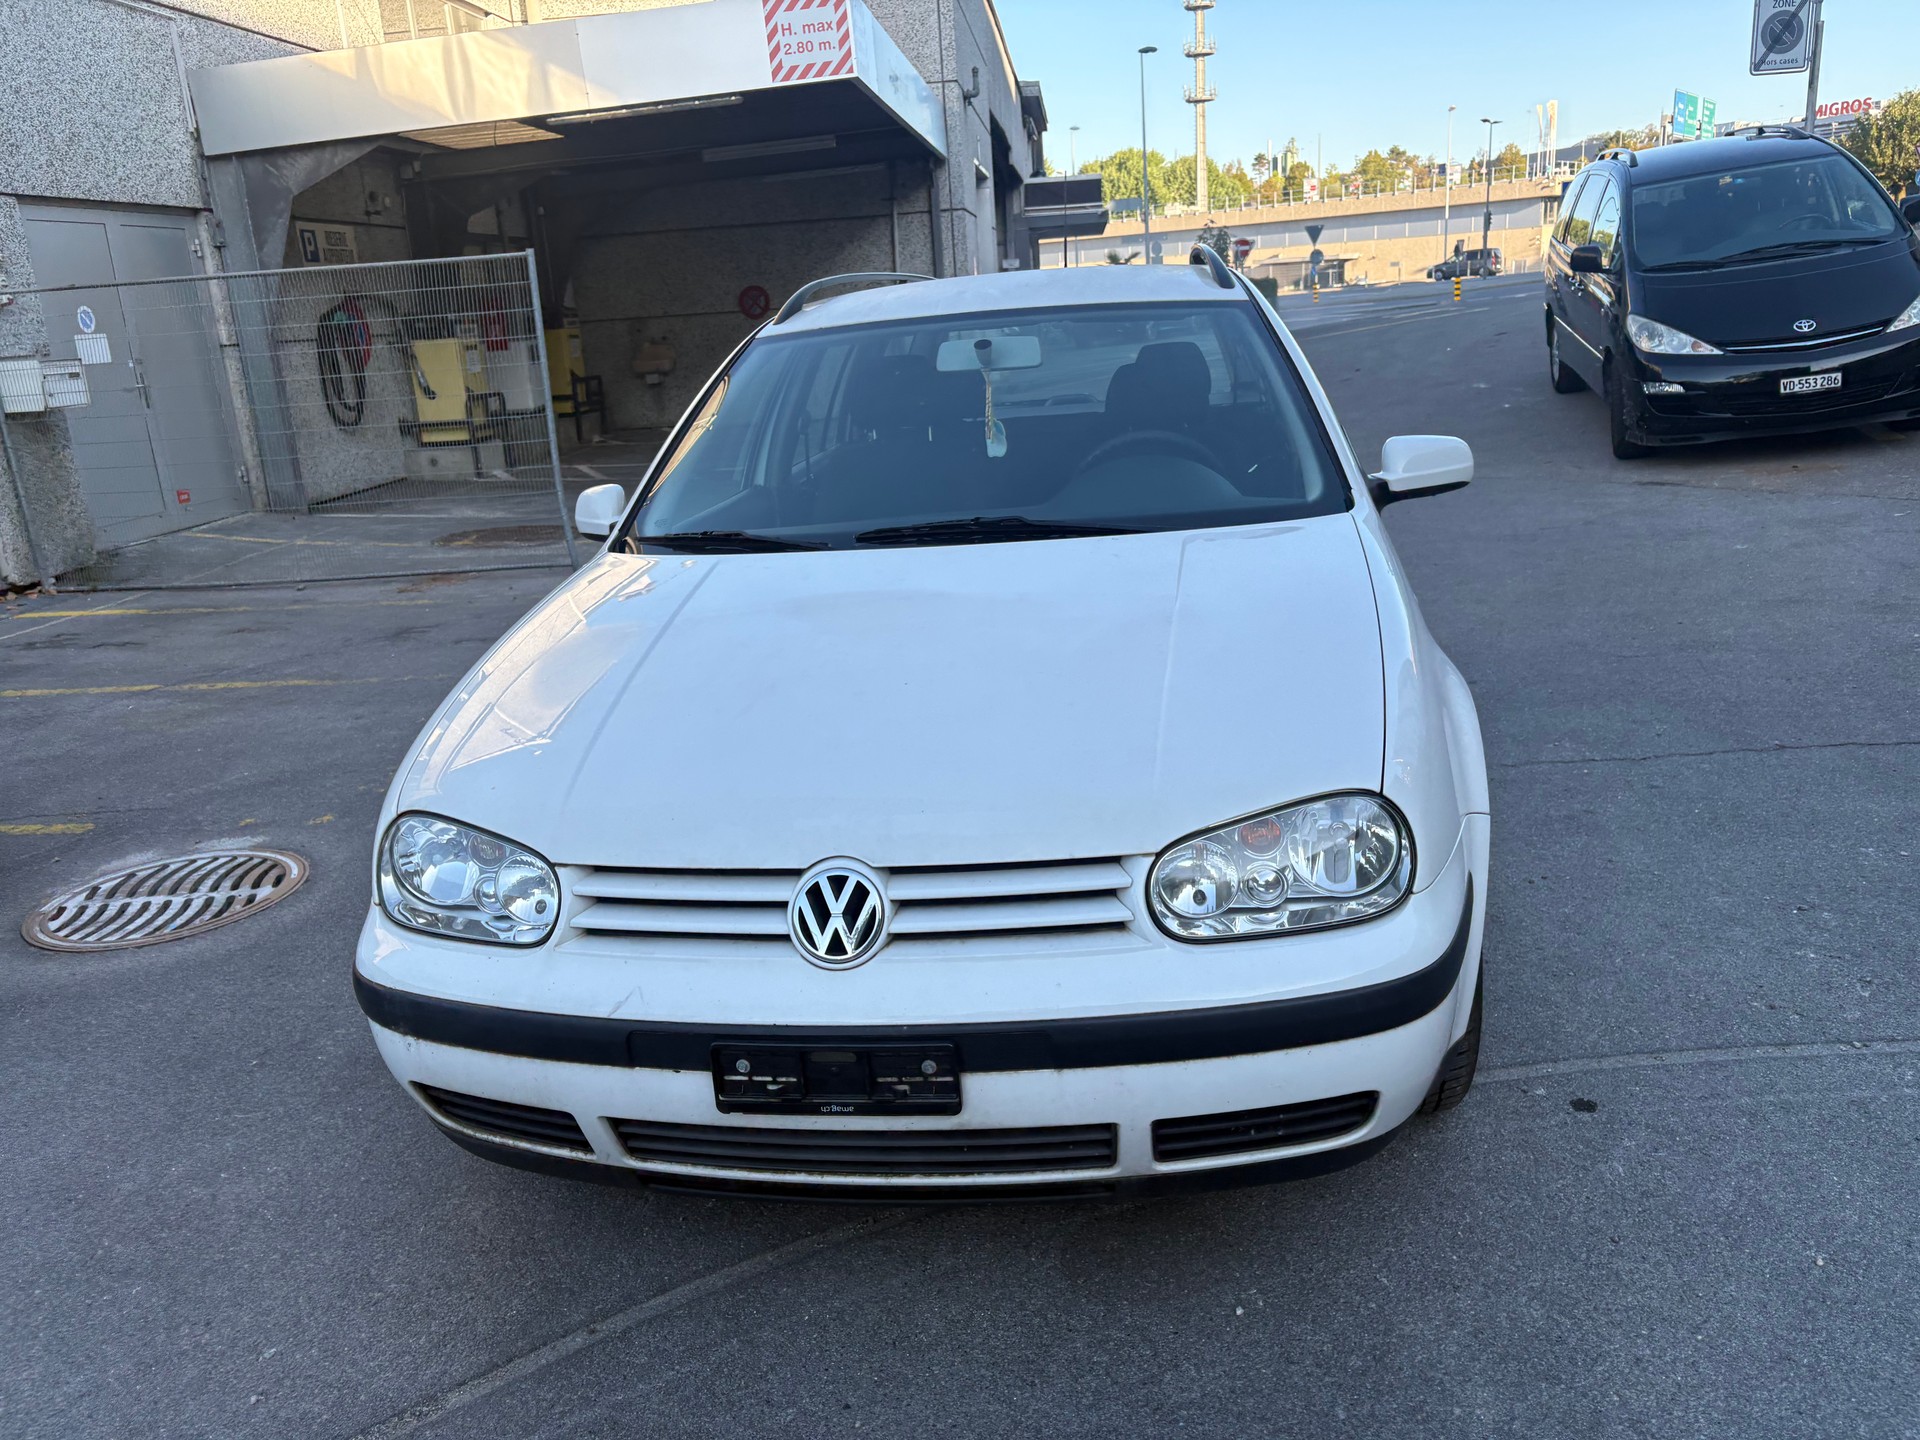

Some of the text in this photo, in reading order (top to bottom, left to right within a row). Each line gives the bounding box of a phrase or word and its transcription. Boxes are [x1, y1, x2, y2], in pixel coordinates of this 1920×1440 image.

[1772, 0, 1797, 9] ZONE
[781, 20, 834, 37] H. max
[783, 40, 836, 56] 2.80 m.
